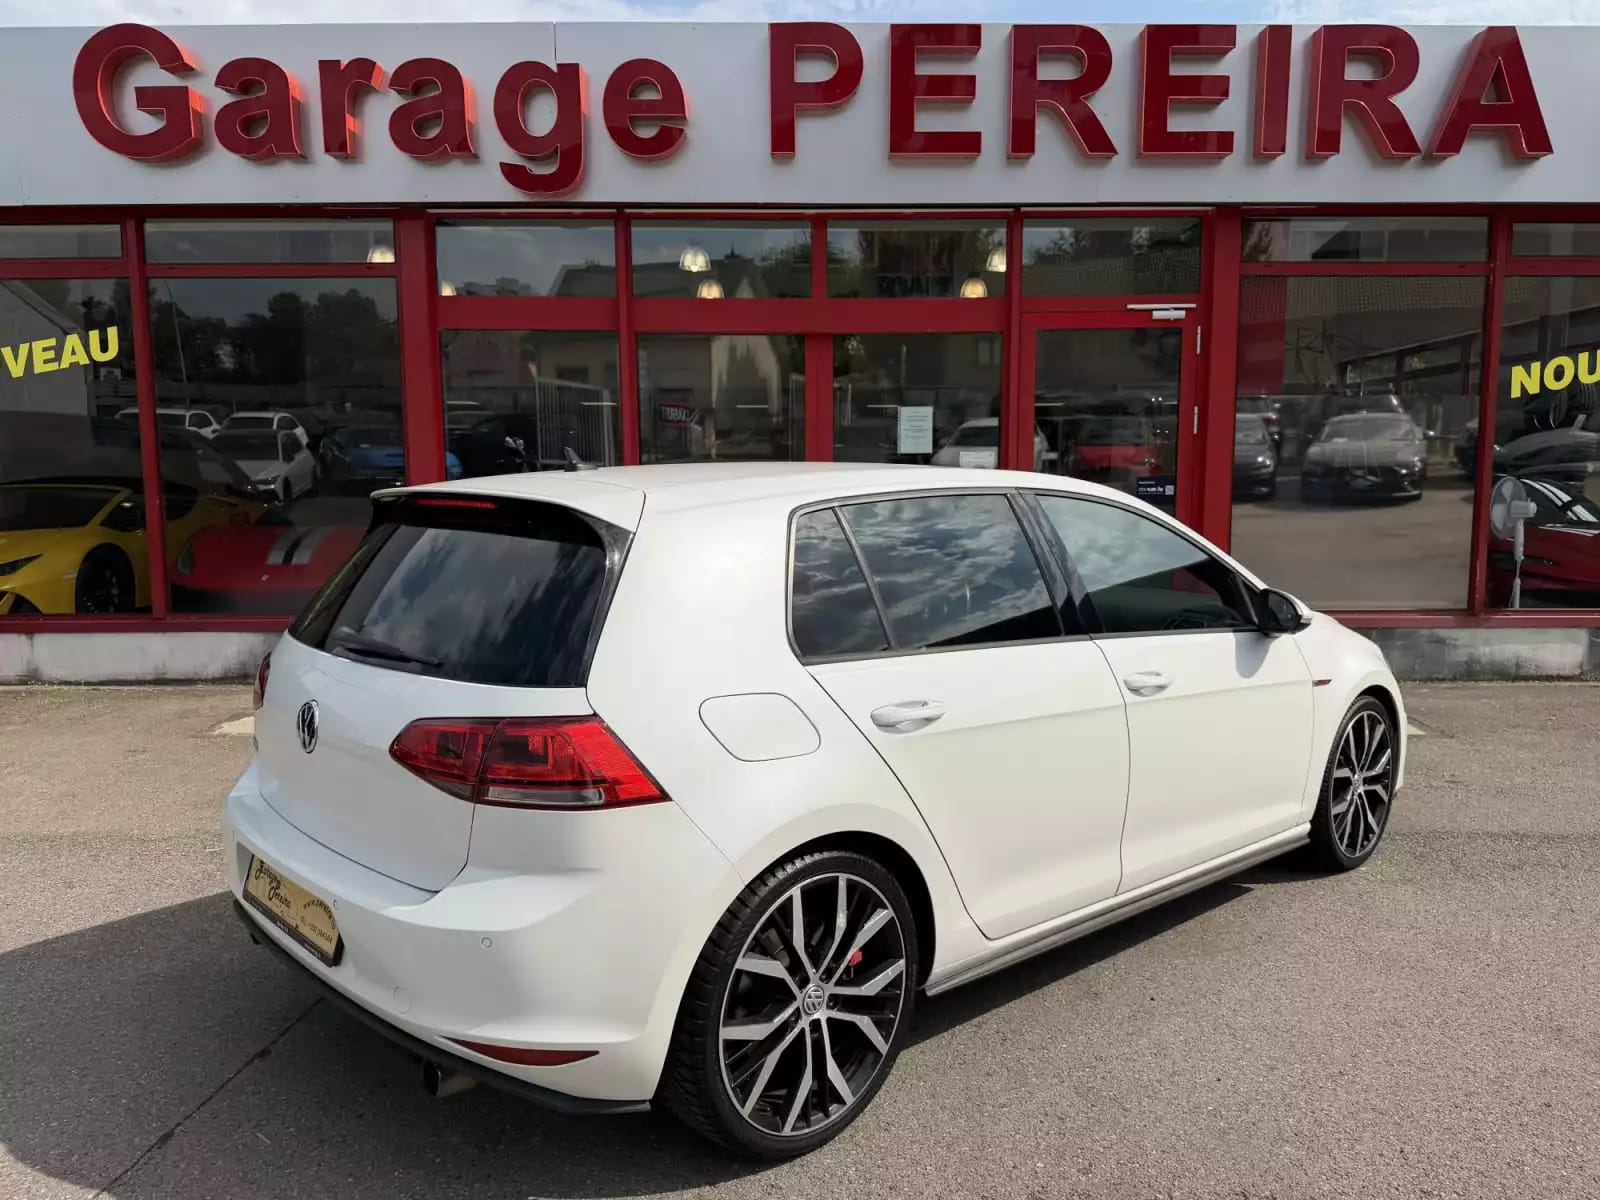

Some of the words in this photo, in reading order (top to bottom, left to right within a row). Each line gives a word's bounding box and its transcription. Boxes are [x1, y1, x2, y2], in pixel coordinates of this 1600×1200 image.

[73, 23, 688, 194] Garage
[768, 22, 1554, 160] PEREIRA
[0, 326, 119, 378] VEAU
[1510, 348, 1600, 399] NOU
